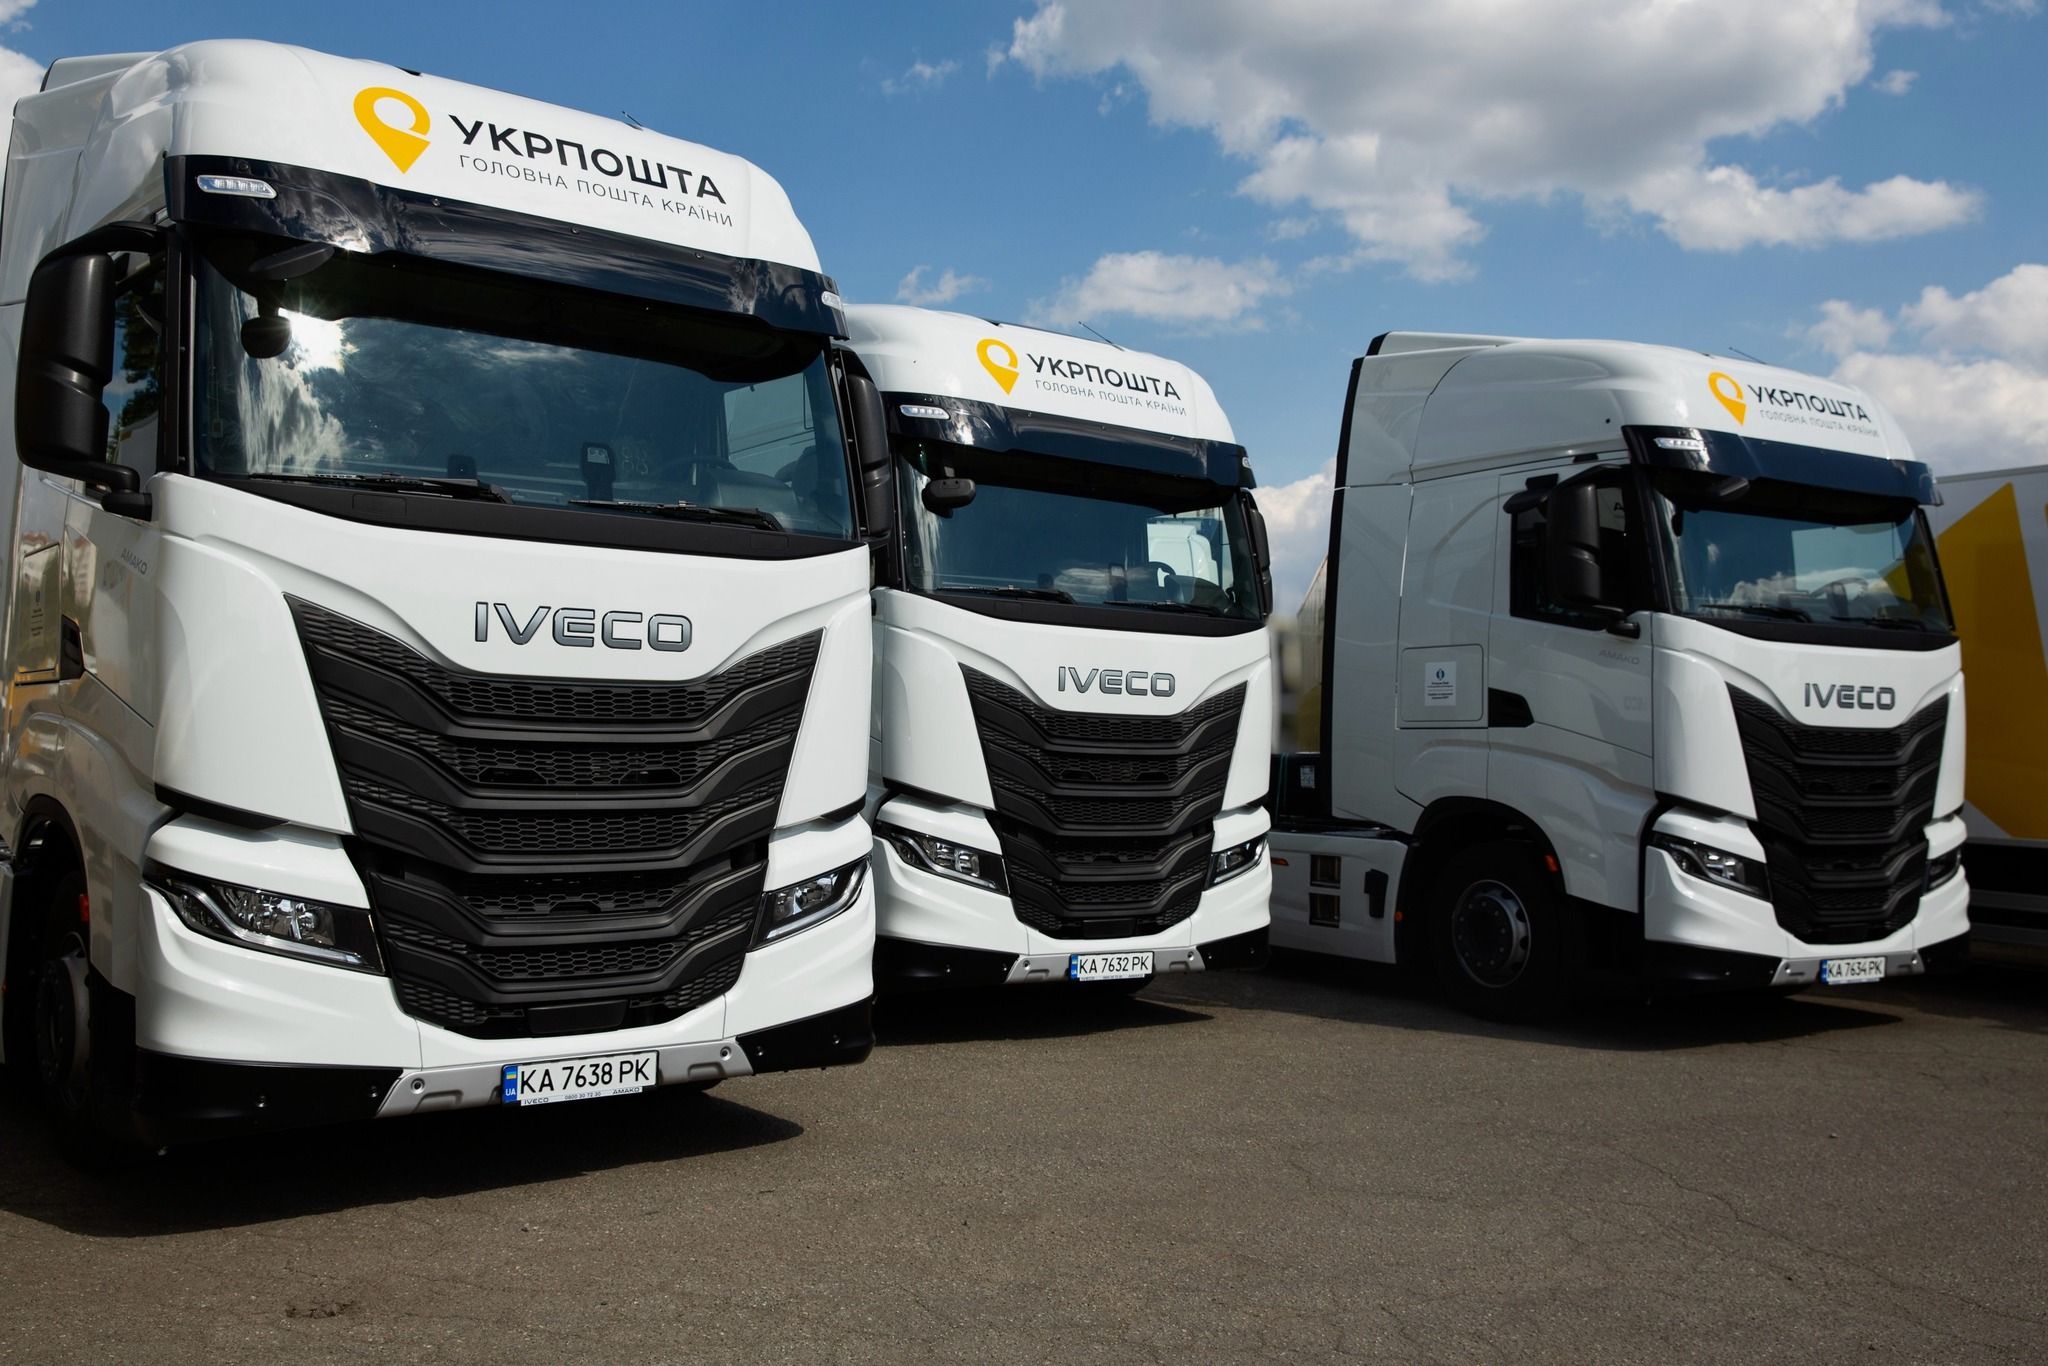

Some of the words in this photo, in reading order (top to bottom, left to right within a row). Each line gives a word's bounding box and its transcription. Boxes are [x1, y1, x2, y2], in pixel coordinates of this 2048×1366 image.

[448, 114, 727, 205] УКРПОШТА
[459, 154, 569, 190] ГОЛОВНА
[576, 179, 654, 209] ПОШТА
[661, 198, 734, 228] КРАЇНИ
[1026, 353, 1182, 401] УКРПОШТА
[1035, 379, 1096, 399] ГОЛОВНА
[1098, 390, 1143, 408] ПОШТА
[1145, 399, 1188, 417] КРАЇНИ
[1747, 384, 1872, 423] УКРПОШТА
[474, 600, 693, 653] IVECO
[1057, 665, 1176, 698] IVECO
[1804, 682, 1896, 711] IVECO
[1079, 958, 1098, 974] KA
[1101, 956, 1129, 973] 7632
[1131, 955, 1150, 971] PK
[1827, 962, 1842, 978] KA
[1844, 961, 1867, 976] 7634
[1868, 960, 1883, 975] PK
[505, 1087, 517, 1097] UA
[520, 1068, 555, 1095] KA
[561, 1062, 613, 1091] 7638
[618, 1057, 651, 1084] PK
[523, 1096, 550, 1105] IVECO
[564, 1092, 579, 1100] 0800
[611, 1086, 640, 1095] AMAKO
